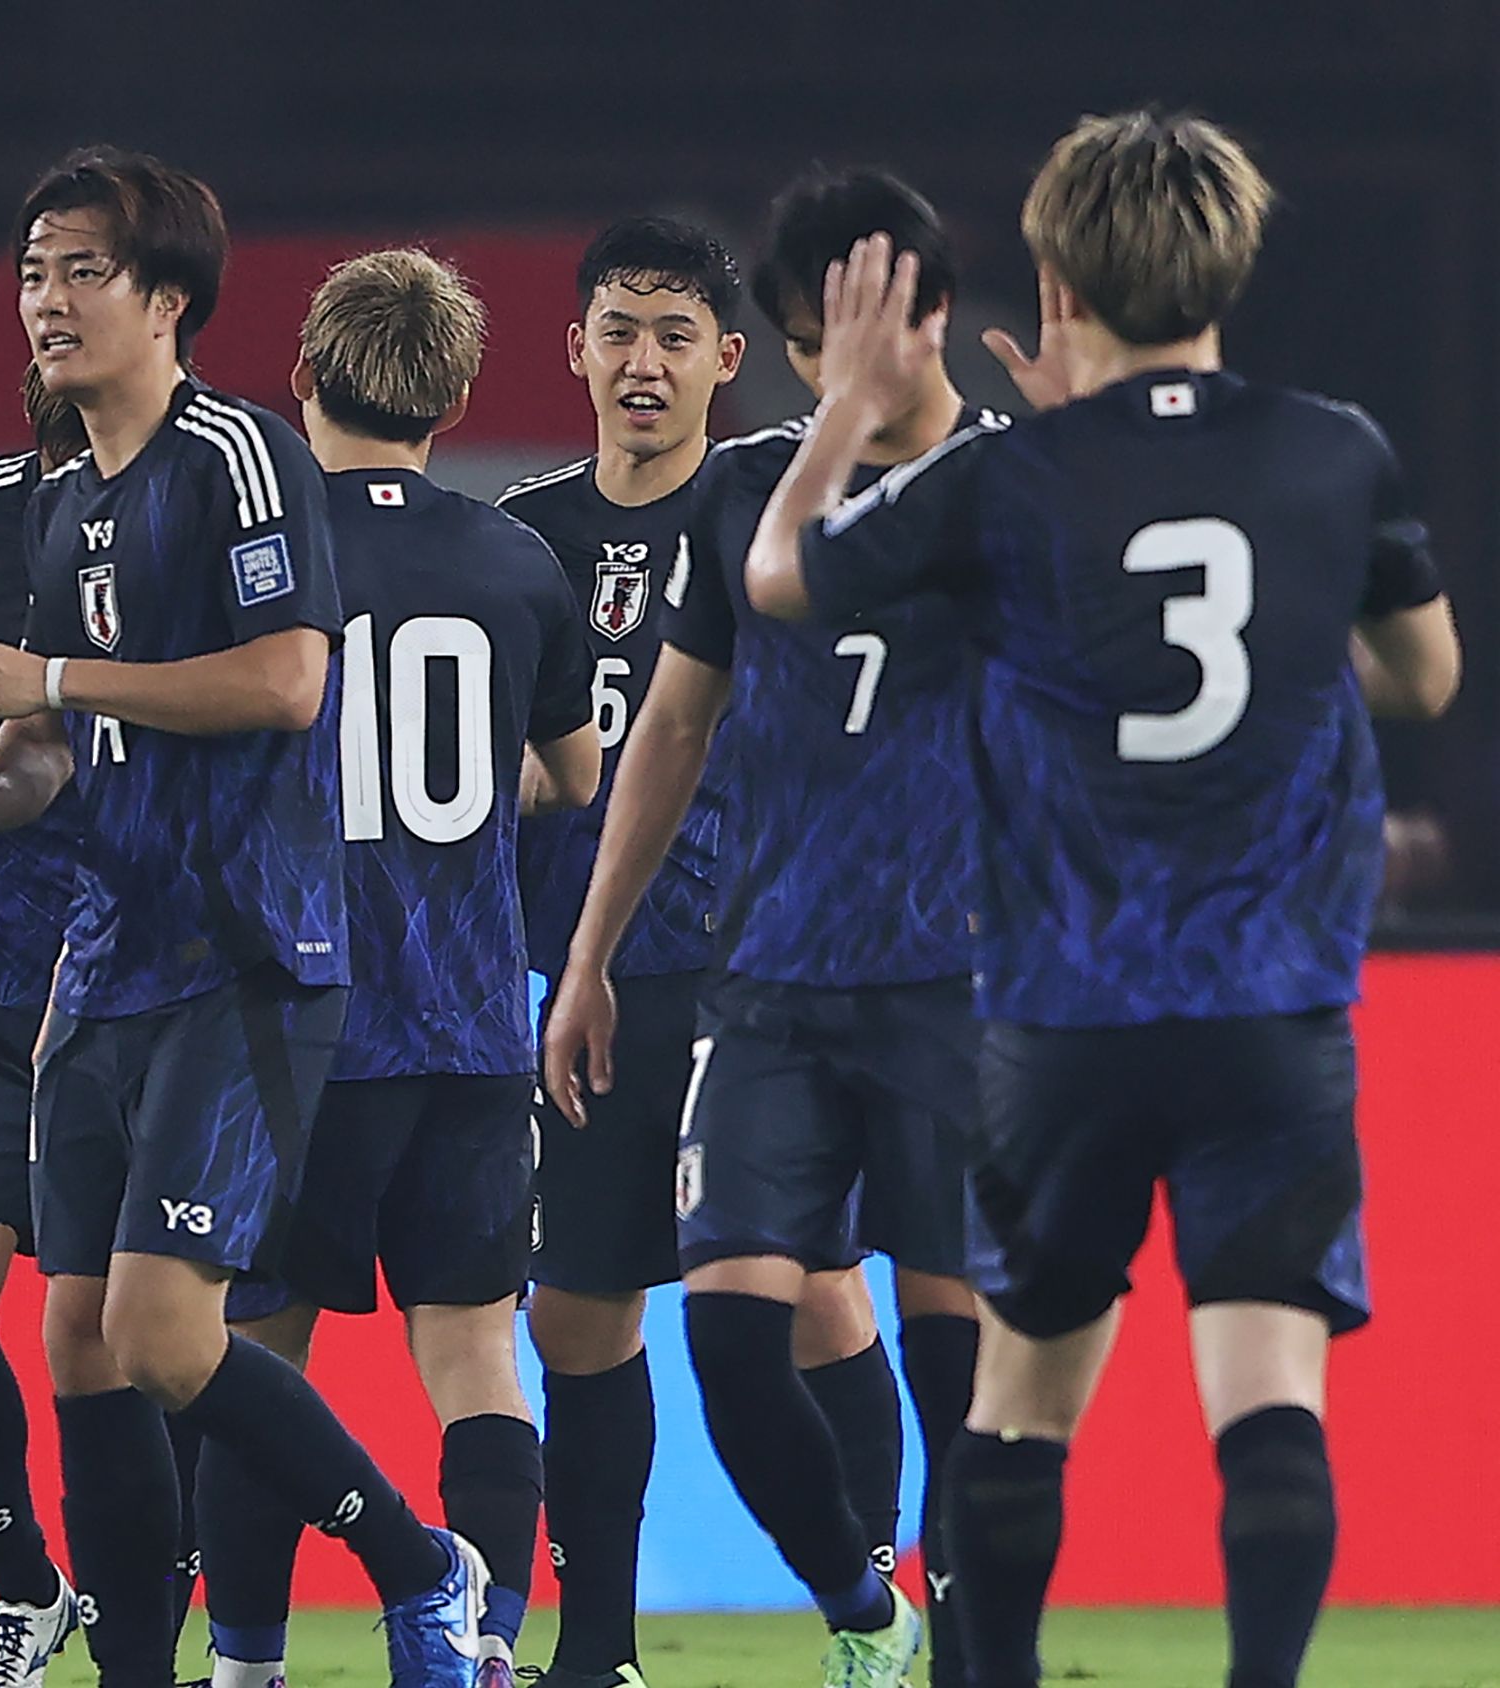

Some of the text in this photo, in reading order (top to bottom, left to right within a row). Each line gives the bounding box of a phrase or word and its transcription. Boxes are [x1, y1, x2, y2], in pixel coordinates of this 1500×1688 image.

[81, 519, 115, 551] Y-3
[601, 543, 649, 563] Y-3
[833, 633, 888, 734] 7
[1117, 516, 1255, 762] 3
[340, 613, 495, 844] 10
[590, 657, 631, 749] 6
[160, 1198, 213, 1235] Y-3
